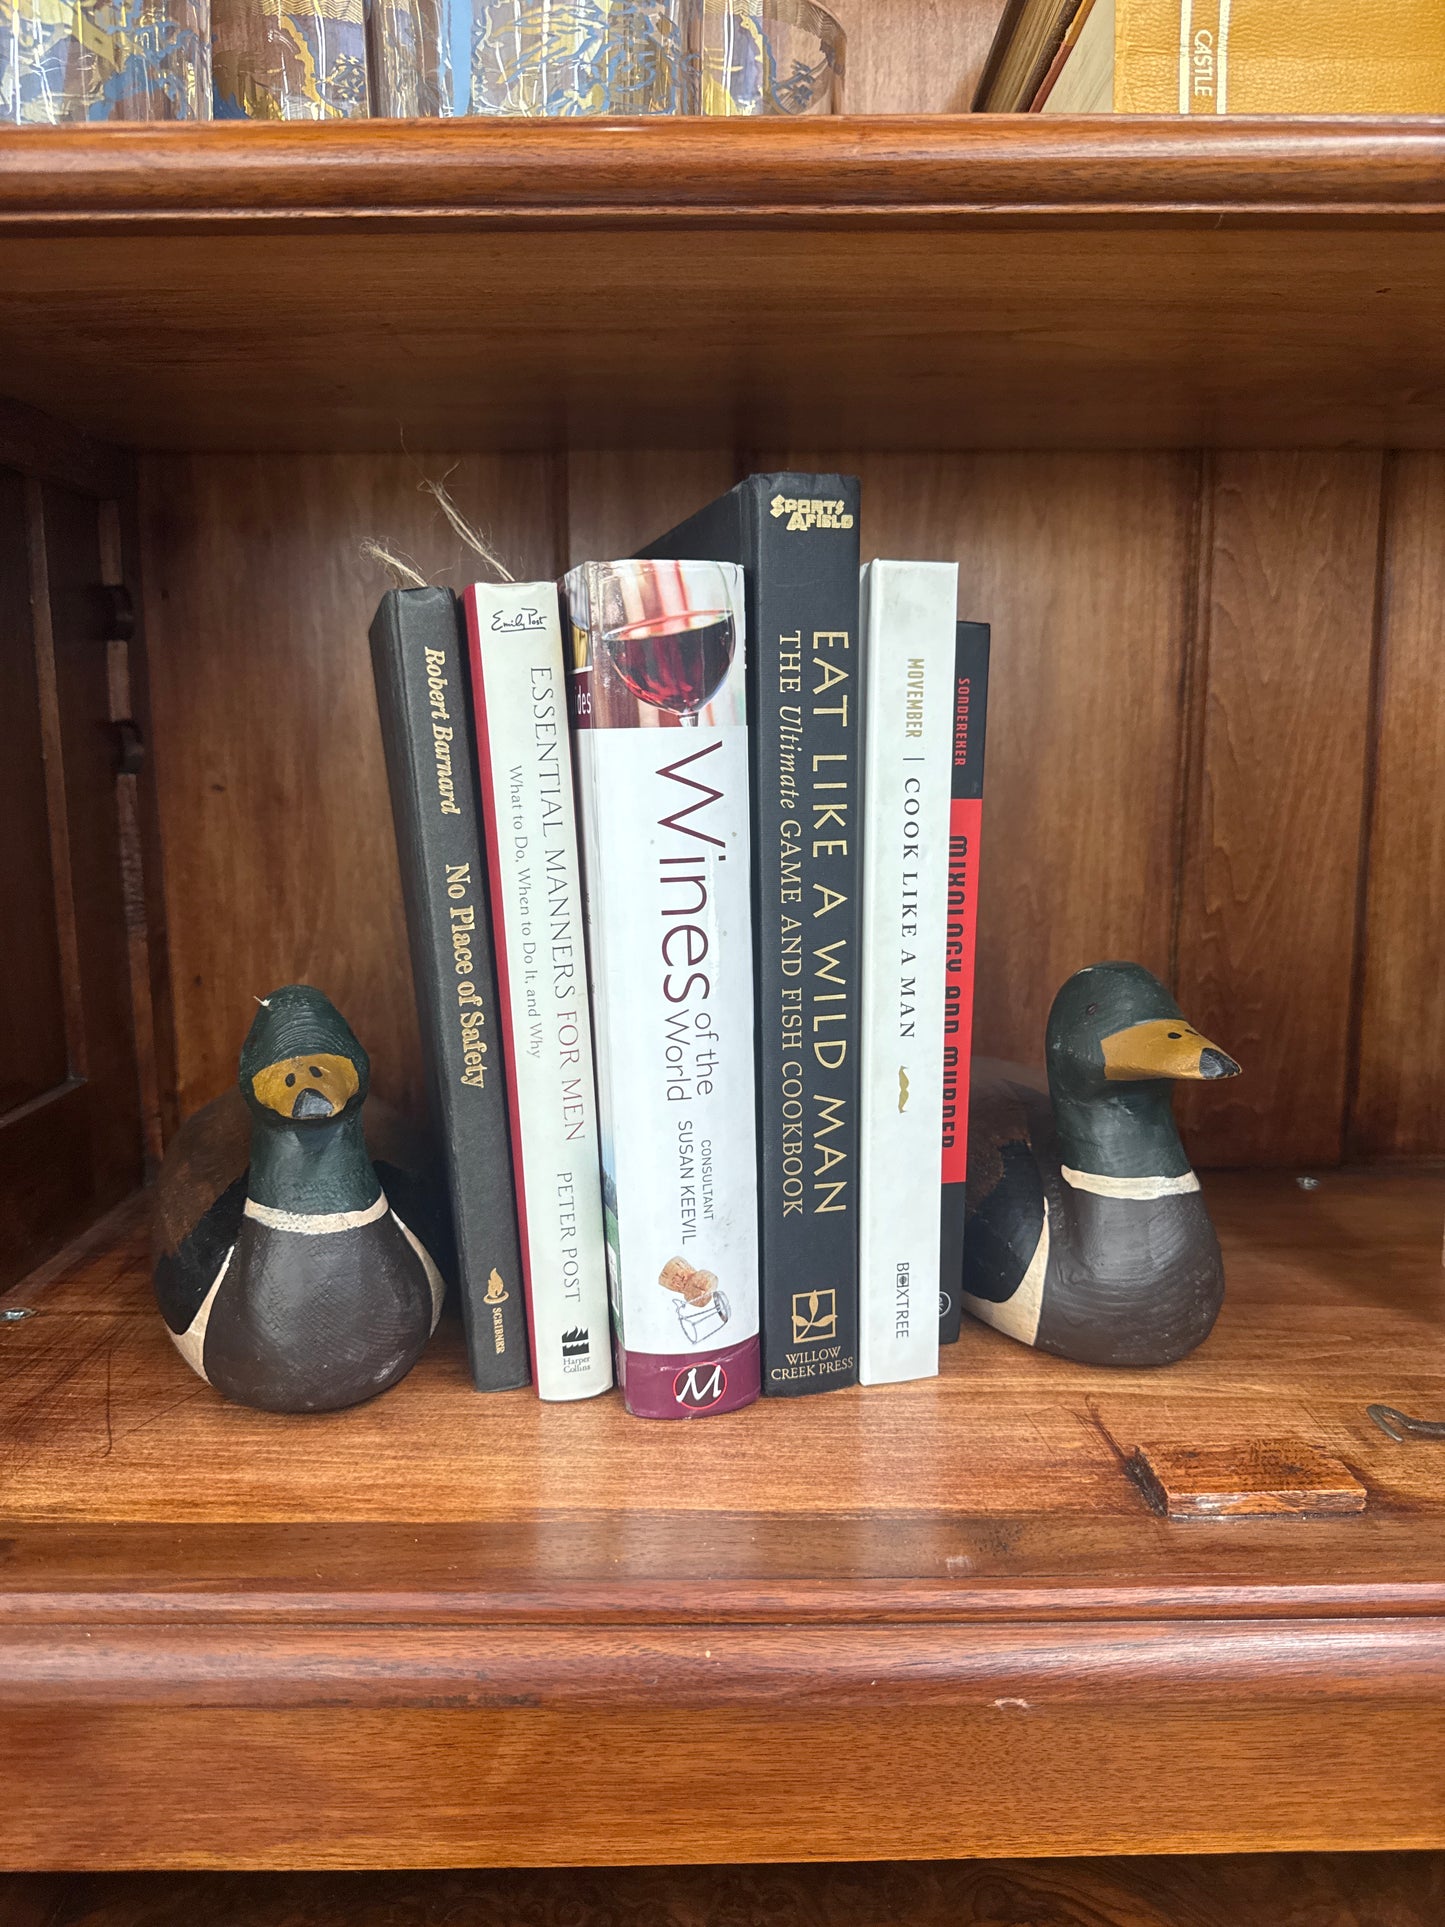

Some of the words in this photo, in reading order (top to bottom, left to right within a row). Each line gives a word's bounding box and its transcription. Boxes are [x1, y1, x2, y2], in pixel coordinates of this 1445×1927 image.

[1194, 29, 1212, 96] CASTLE
[424, 646, 450, 720] Robert
[779, 629, 802, 693] THE
[812, 631, 850, 727] EAT
[905, 658, 925, 738] MOVEMBER
[954, 678, 970, 766] SONDEREKER
[432, 723, 461, 815] Barnard
[530, 667, 564, 838] ESSENTIAL
[779, 705, 804, 809] Ultimate
[508, 765, 525, 810] What
[812, 754, 848, 858] LIKE
[903, 777, 920, 860] COOK
[513, 813, 525, 830] to
[445, 862, 471, 899] No
[517, 868, 534, 916] When
[655, 741, 727, 1003] Wines
[780, 819, 802, 904] GAME
[521, 921, 531, 936] to
[545, 849, 576, 999] MANNERS
[812, 883, 848, 918] A
[902, 872, 918, 938] LIKE
[450, 905, 475, 975] Place
[523, 942, 537, 965] Do
[781, 914, 802, 977] AND
[901, 949, 916, 965] A
[457, 981, 484, 1008] of
[527, 989, 541, 1017] and
[781, 987, 803, 1050] FISH
[812, 939, 847, 1069] WILD
[900, 977, 915, 1038] MAN
[460, 1010, 488, 1089] Safety
[527, 1022, 543, 1058] Why
[557, 1011, 580, 1069] FOR
[664, 1009, 692, 1101] World
[695, 1012, 719, 1042] of
[696, 1049, 720, 1096] the
[561, 1078, 586, 1141] MEN
[781, 1060, 803, 1218] COOKBOOK
[678, 1120, 695, 1179] SUSAN
[701, 1139, 714, 1220] CONSULTANT
[812, 1094, 848, 1213] MAN
[557, 1172, 577, 1241] PETER
[680, 1184, 697, 1244] KEEVIL
[562, 1248, 581, 1302] POST
[563, 1357, 591, 1366] Harper
[563, 1364, 591, 1374] Collins
[770, 1365, 816, 1381] CREEK
[819, 1356, 854, 1376] PRESS
[785, 1345, 842, 1366] WILLOW
